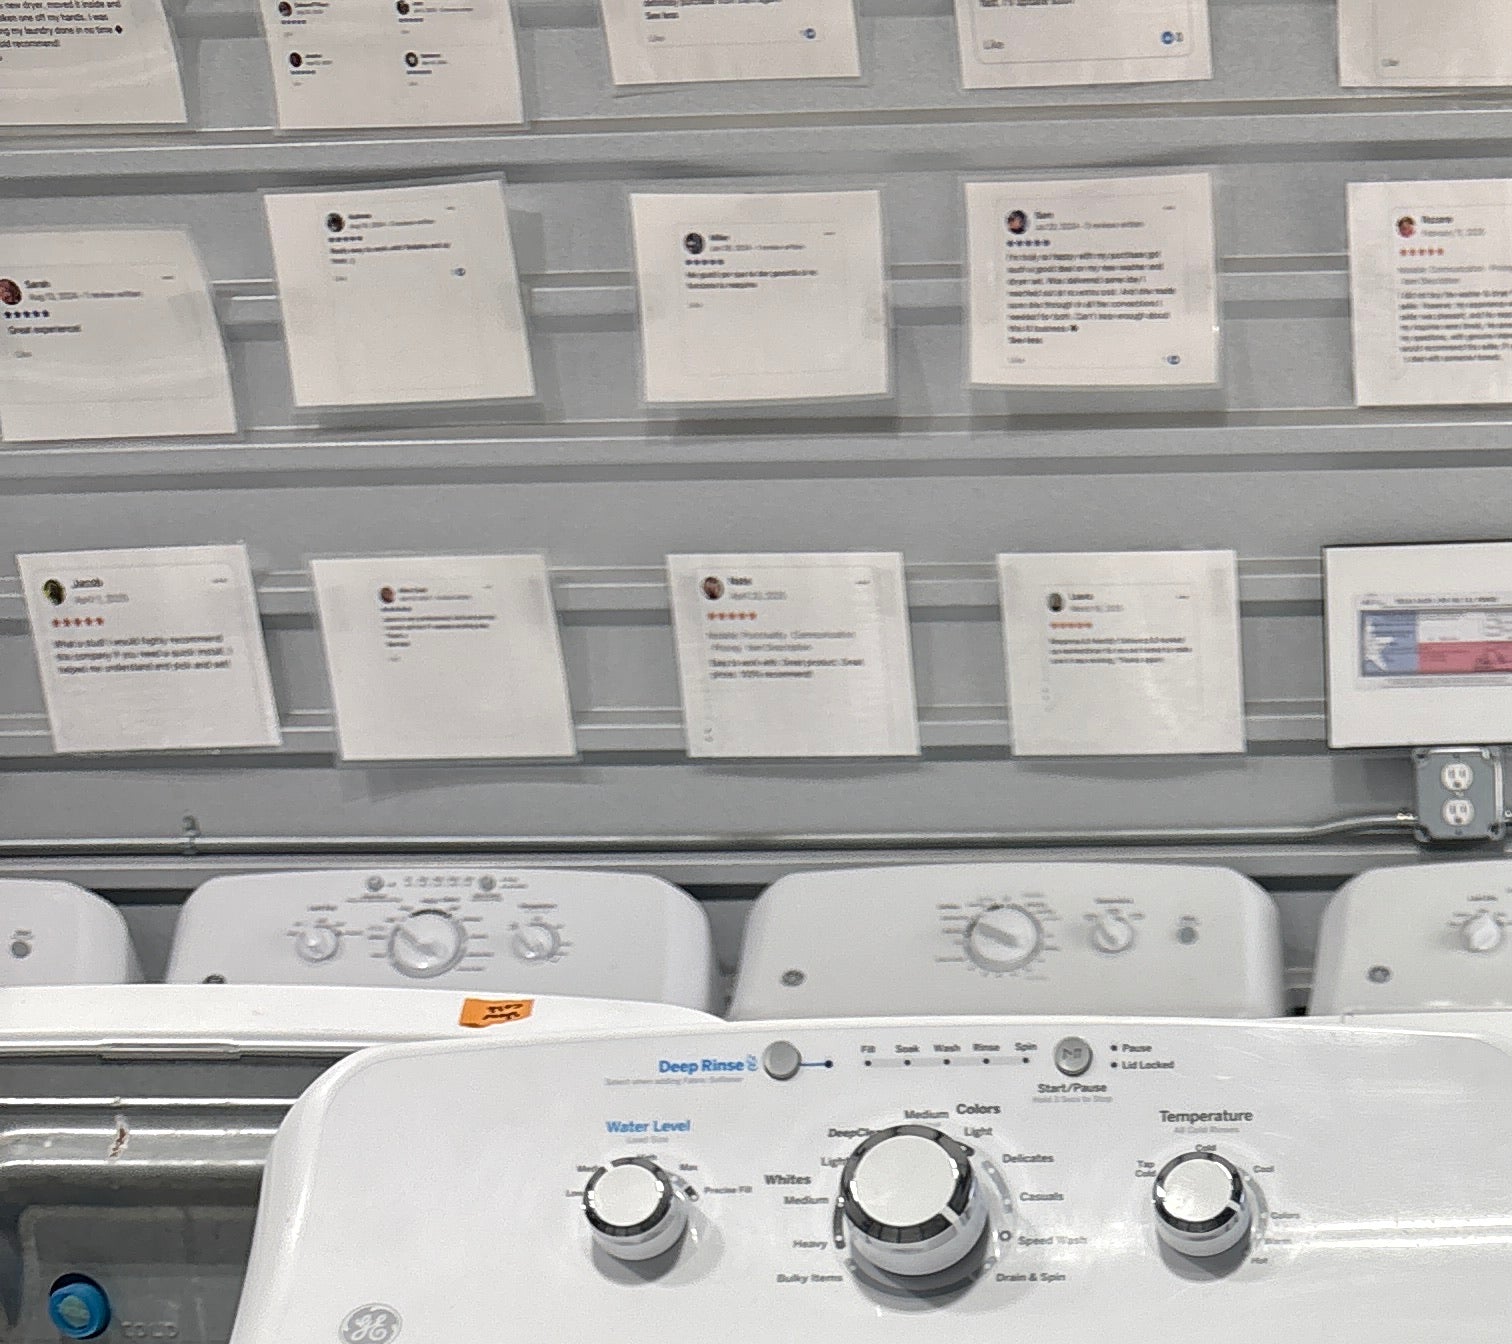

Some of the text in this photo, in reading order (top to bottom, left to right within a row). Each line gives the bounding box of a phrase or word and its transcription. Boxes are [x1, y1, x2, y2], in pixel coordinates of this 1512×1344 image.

[861, 1042, 1038, 1053] Fill Soak Wash Rinse Spin
[1122, 1043, 1153, 1052] Pause
[658, 1058, 745, 1075] Deep Rinse
[1122, 1060, 1176, 1070] Lid Locked
[1037, 1082, 1107, 1094] Start/Pause
[903, 1109, 950, 1120] Medium
[955, 1102, 1001, 1115] Colors
[1158, 1109, 1254, 1125] Temperature
[605, 1119, 691, 1133] Water Level
[964, 1126, 993, 1138] Light
[1002, 1152, 1055, 1163] Delicates
[763, 1173, 812, 1186] Whites
[783, 1195, 830, 1205] Medium
[1019, 1191, 1065, 1201] Casuals
[792, 1239, 829, 1251] Heavy
[1018, 1235, 1054, 1247] Speed
[776, 1273, 843, 1285] Bulky Items
[996, 1273, 1027, 1282] Drain
[1040, 1272, 1066, 1284] Spin
